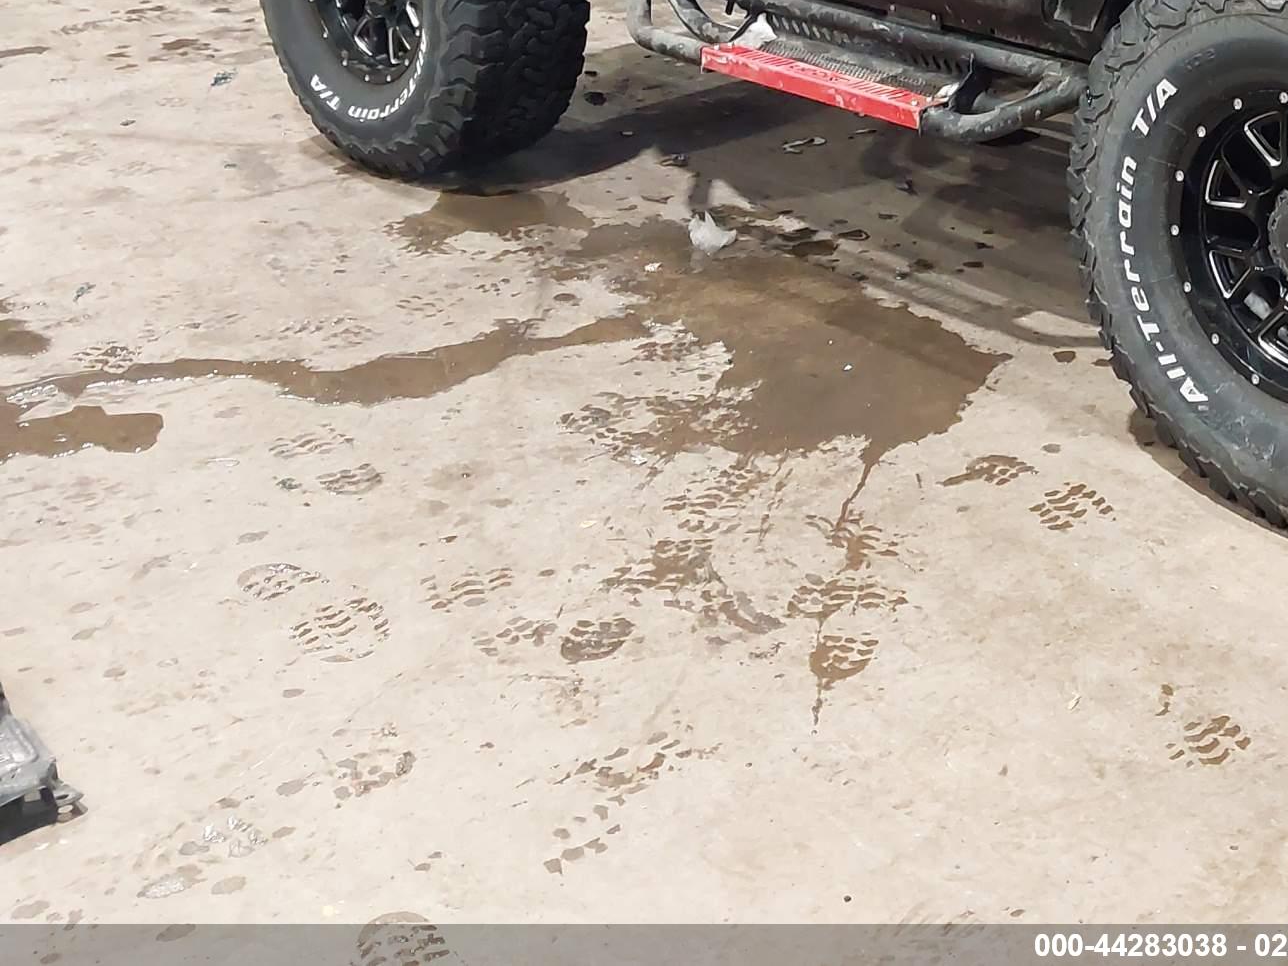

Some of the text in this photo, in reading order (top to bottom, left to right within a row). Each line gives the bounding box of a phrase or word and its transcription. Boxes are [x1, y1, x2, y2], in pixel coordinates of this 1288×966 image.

[310, 27, 428, 123] All-Terrain T/A
[1131, 78, 1179, 137] T/A
[1115, 154, 1210, 405] All-Terrain
